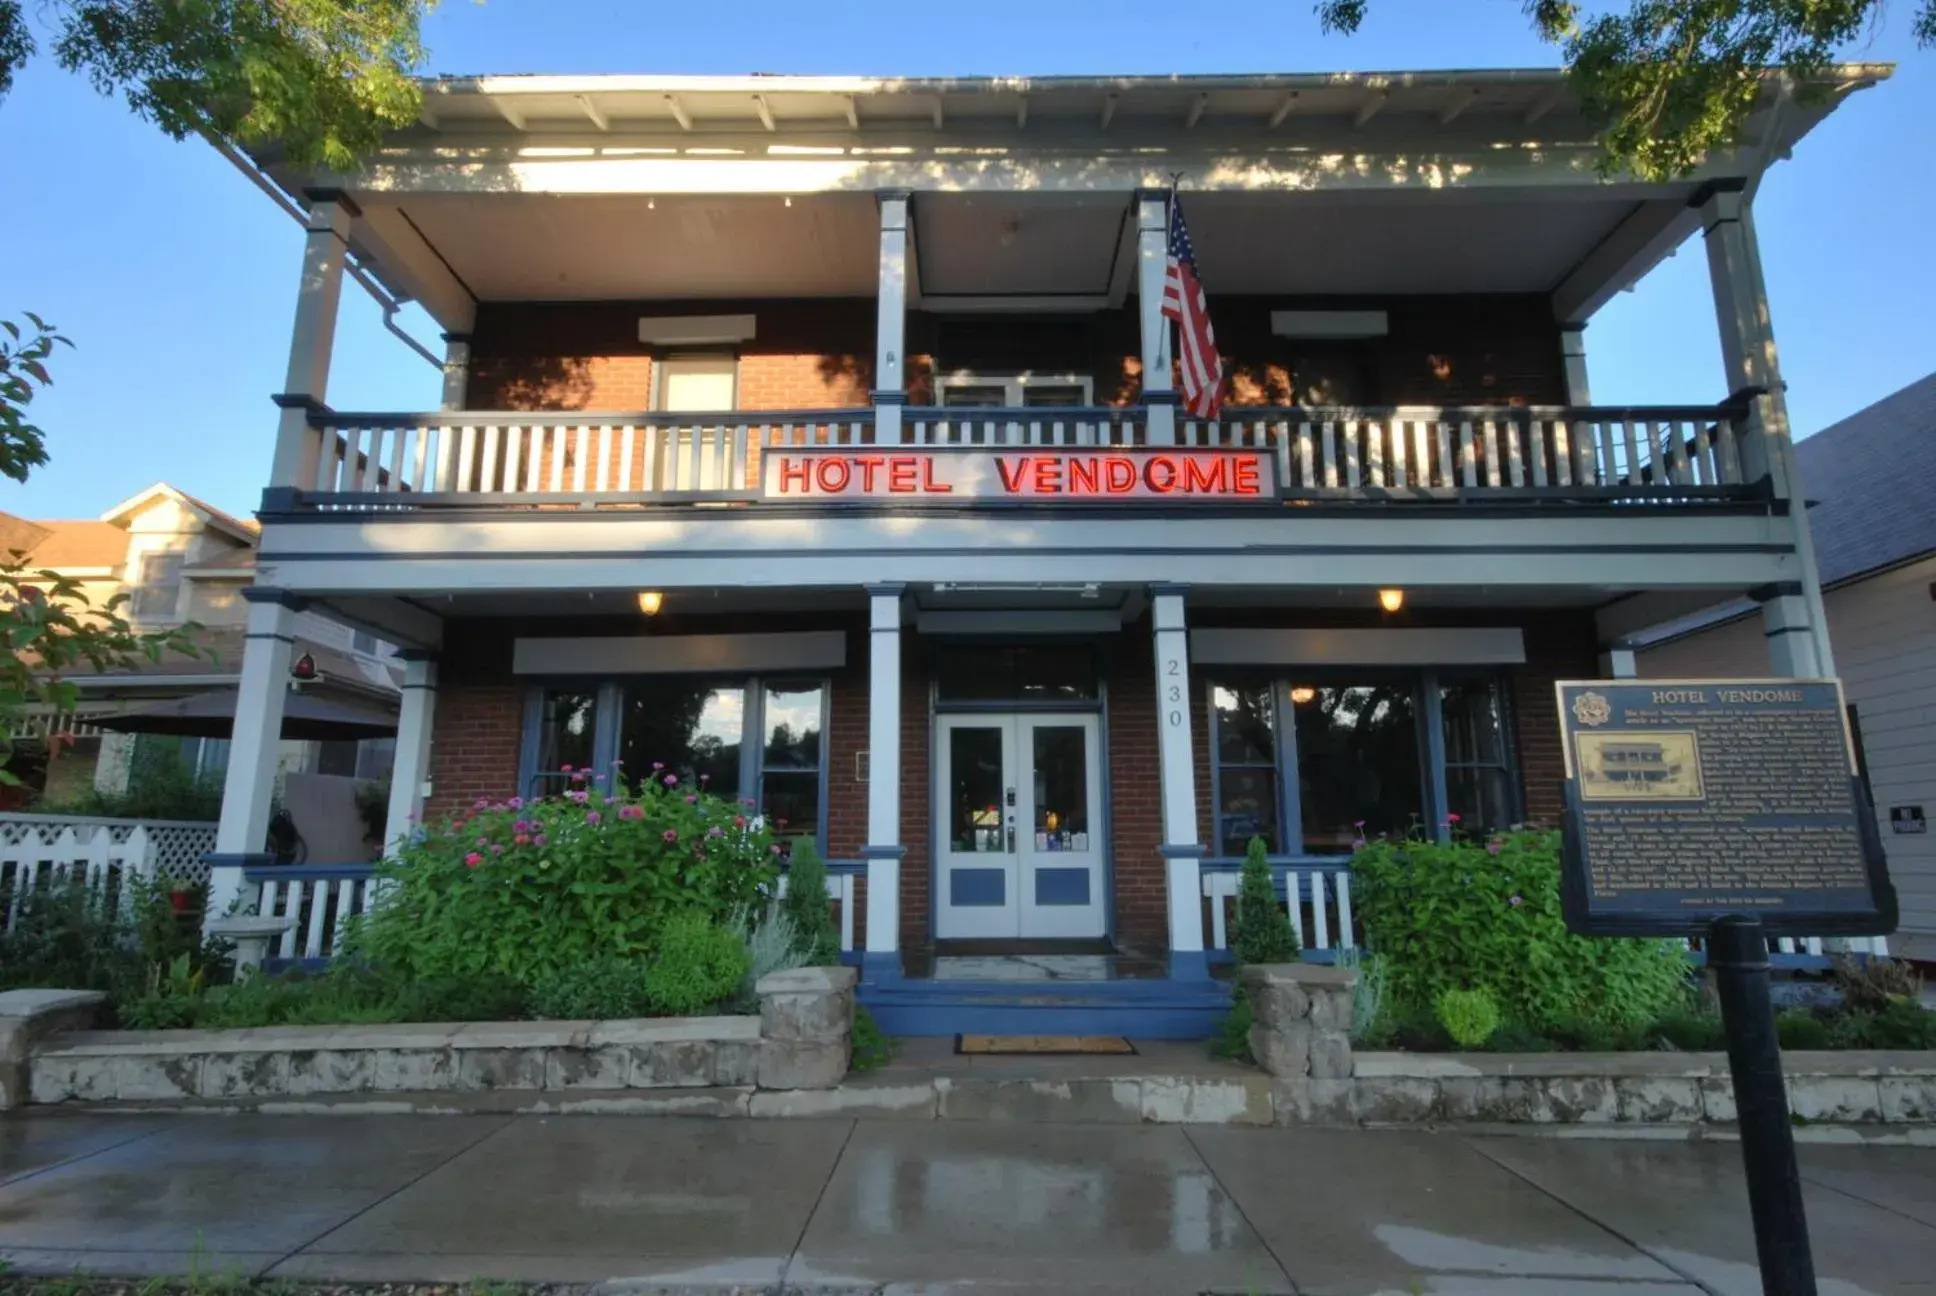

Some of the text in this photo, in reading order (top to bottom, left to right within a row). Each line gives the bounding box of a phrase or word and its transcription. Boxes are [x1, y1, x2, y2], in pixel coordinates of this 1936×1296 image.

[779, 455, 1261, 494] HOTEL VENDOME
[1168, 659, 1182, 728] 230
[1652, 690, 1803, 704] HOTEL VENDOME
